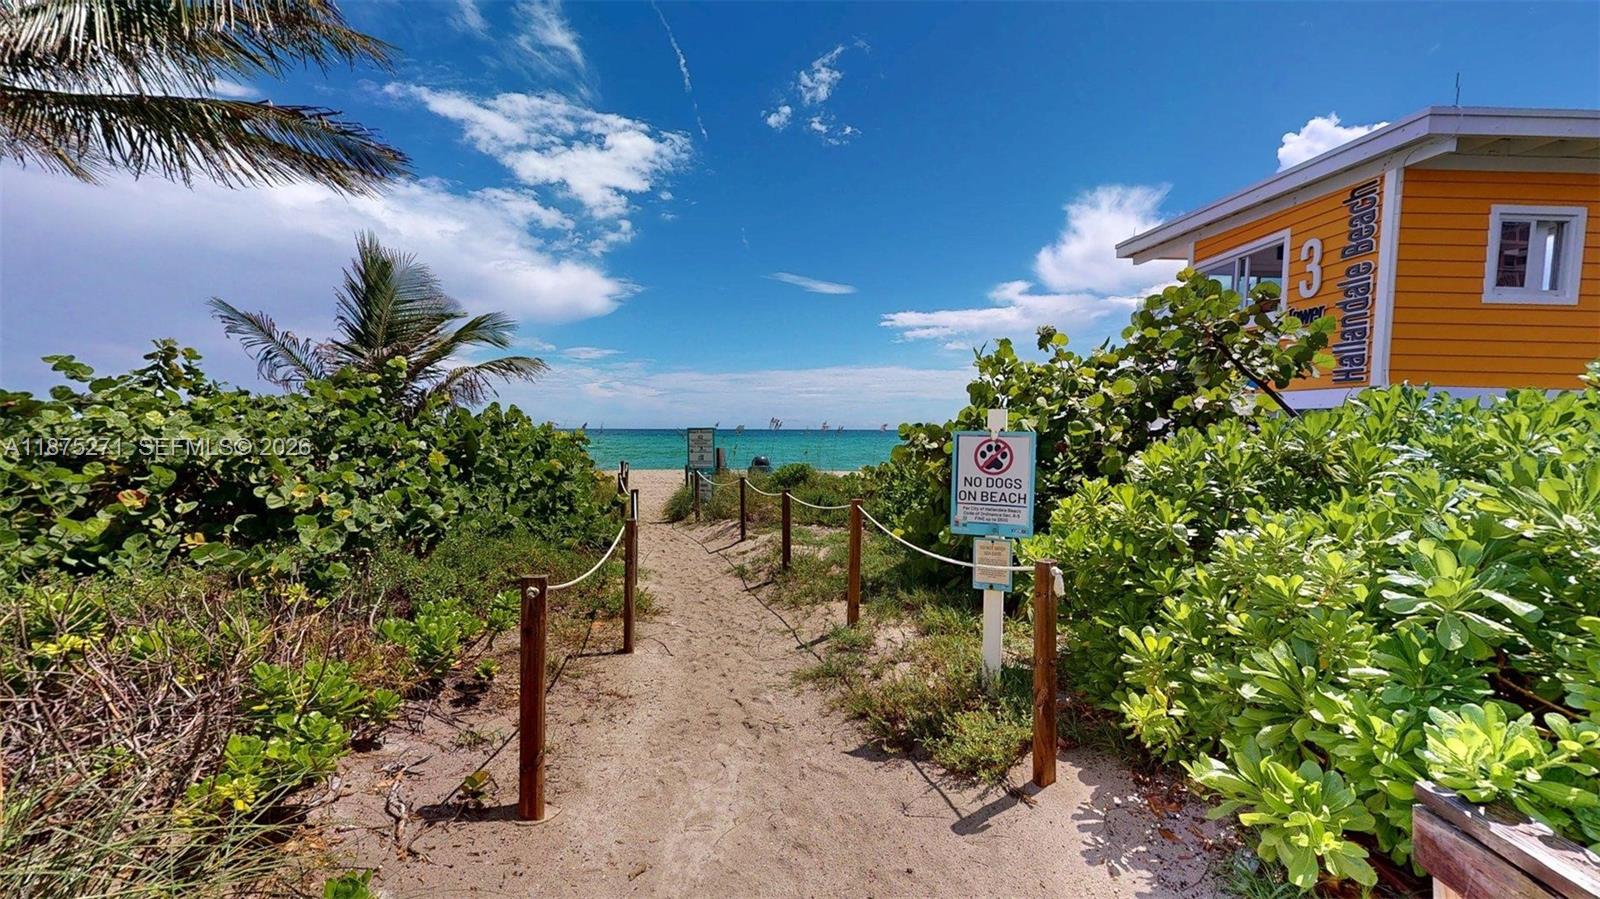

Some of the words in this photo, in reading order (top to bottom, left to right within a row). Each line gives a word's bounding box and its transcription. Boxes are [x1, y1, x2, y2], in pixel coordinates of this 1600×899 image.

[1341, 178, 1380, 261] Beach
[1298, 237, 1323, 298] 3
[1332, 261, 1374, 383] Hallandale
[958, 490, 977, 501] ON
[980, 491, 1027, 504] BEACH
[964, 476, 982, 488] NO
[986, 477, 1022, 490] DOGS
